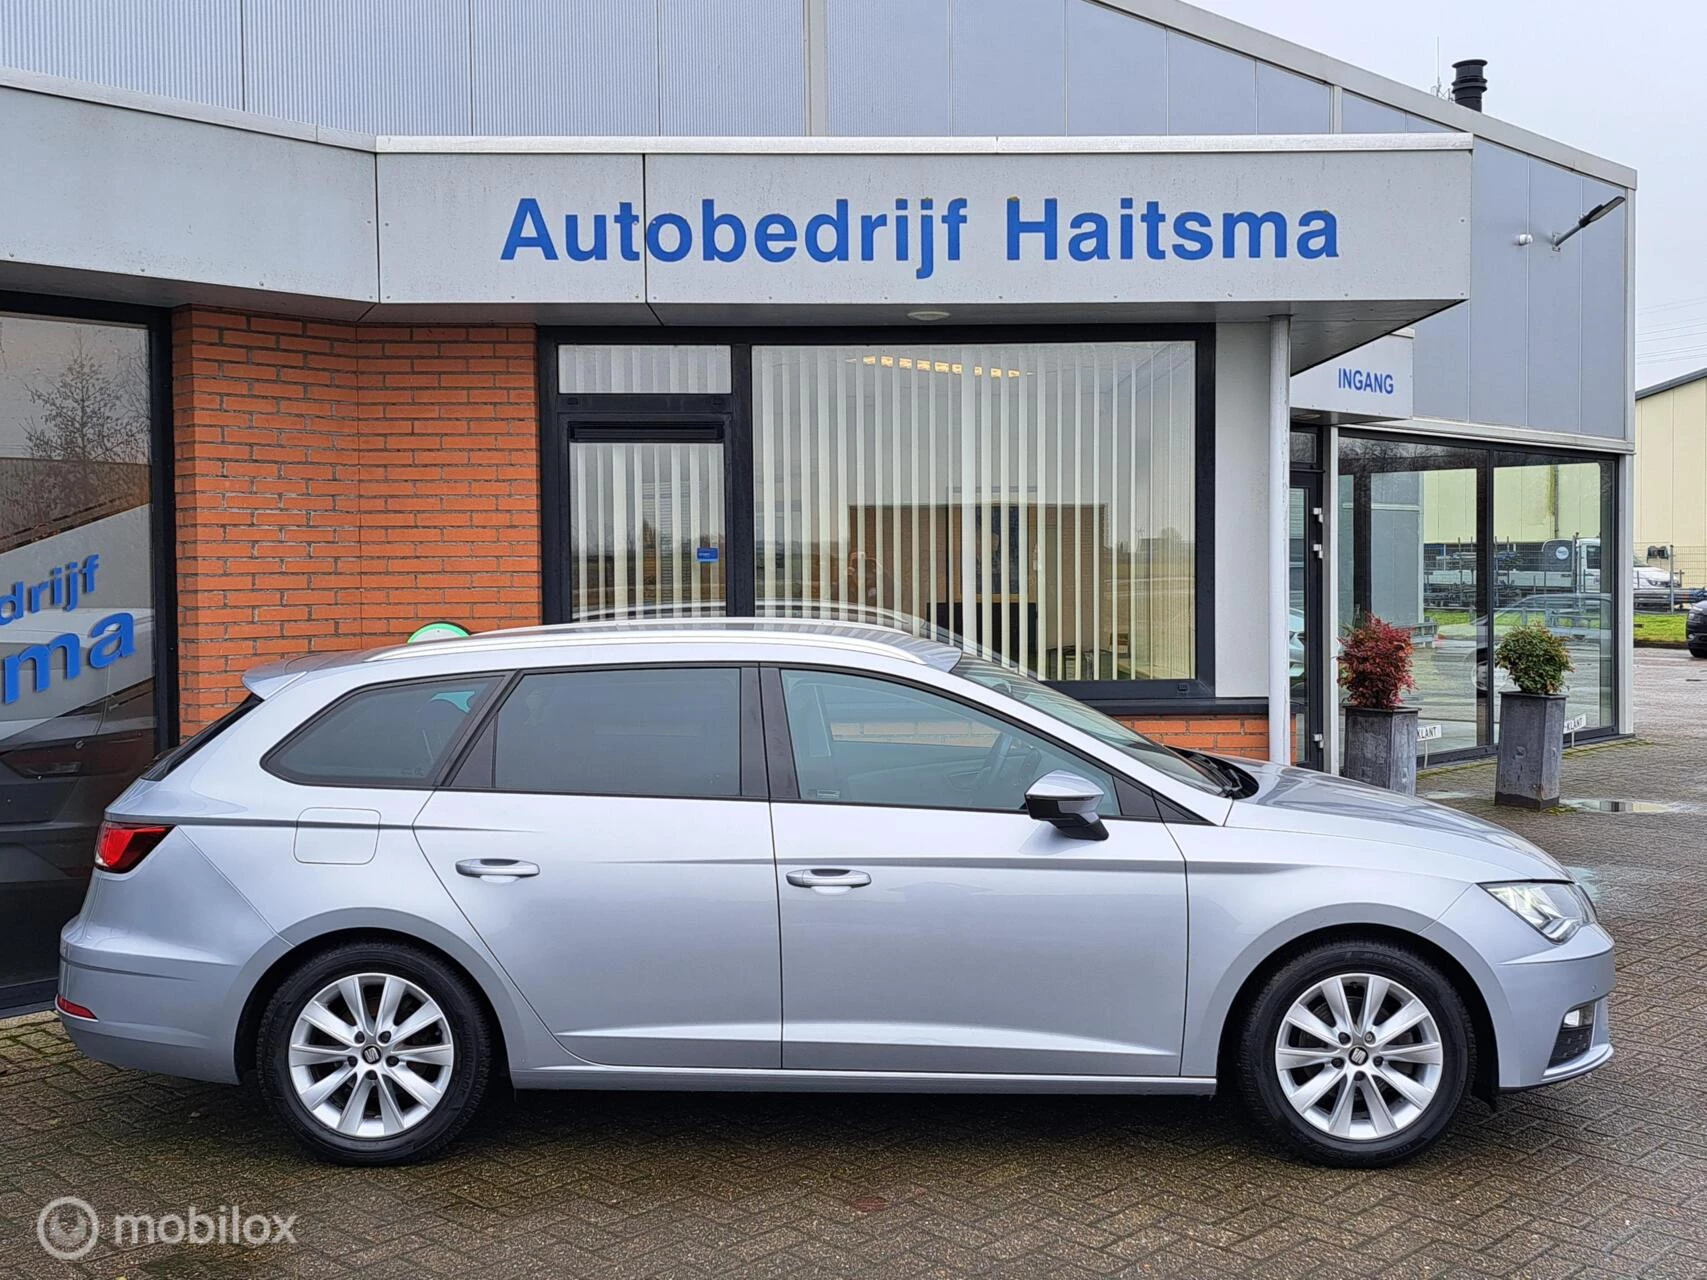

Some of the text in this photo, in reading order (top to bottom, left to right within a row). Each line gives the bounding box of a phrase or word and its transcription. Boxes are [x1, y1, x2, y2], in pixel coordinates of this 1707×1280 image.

[500, 196, 1339, 279] Autobedrijf Haitsma
[1338, 368, 1394, 395] INGANG
